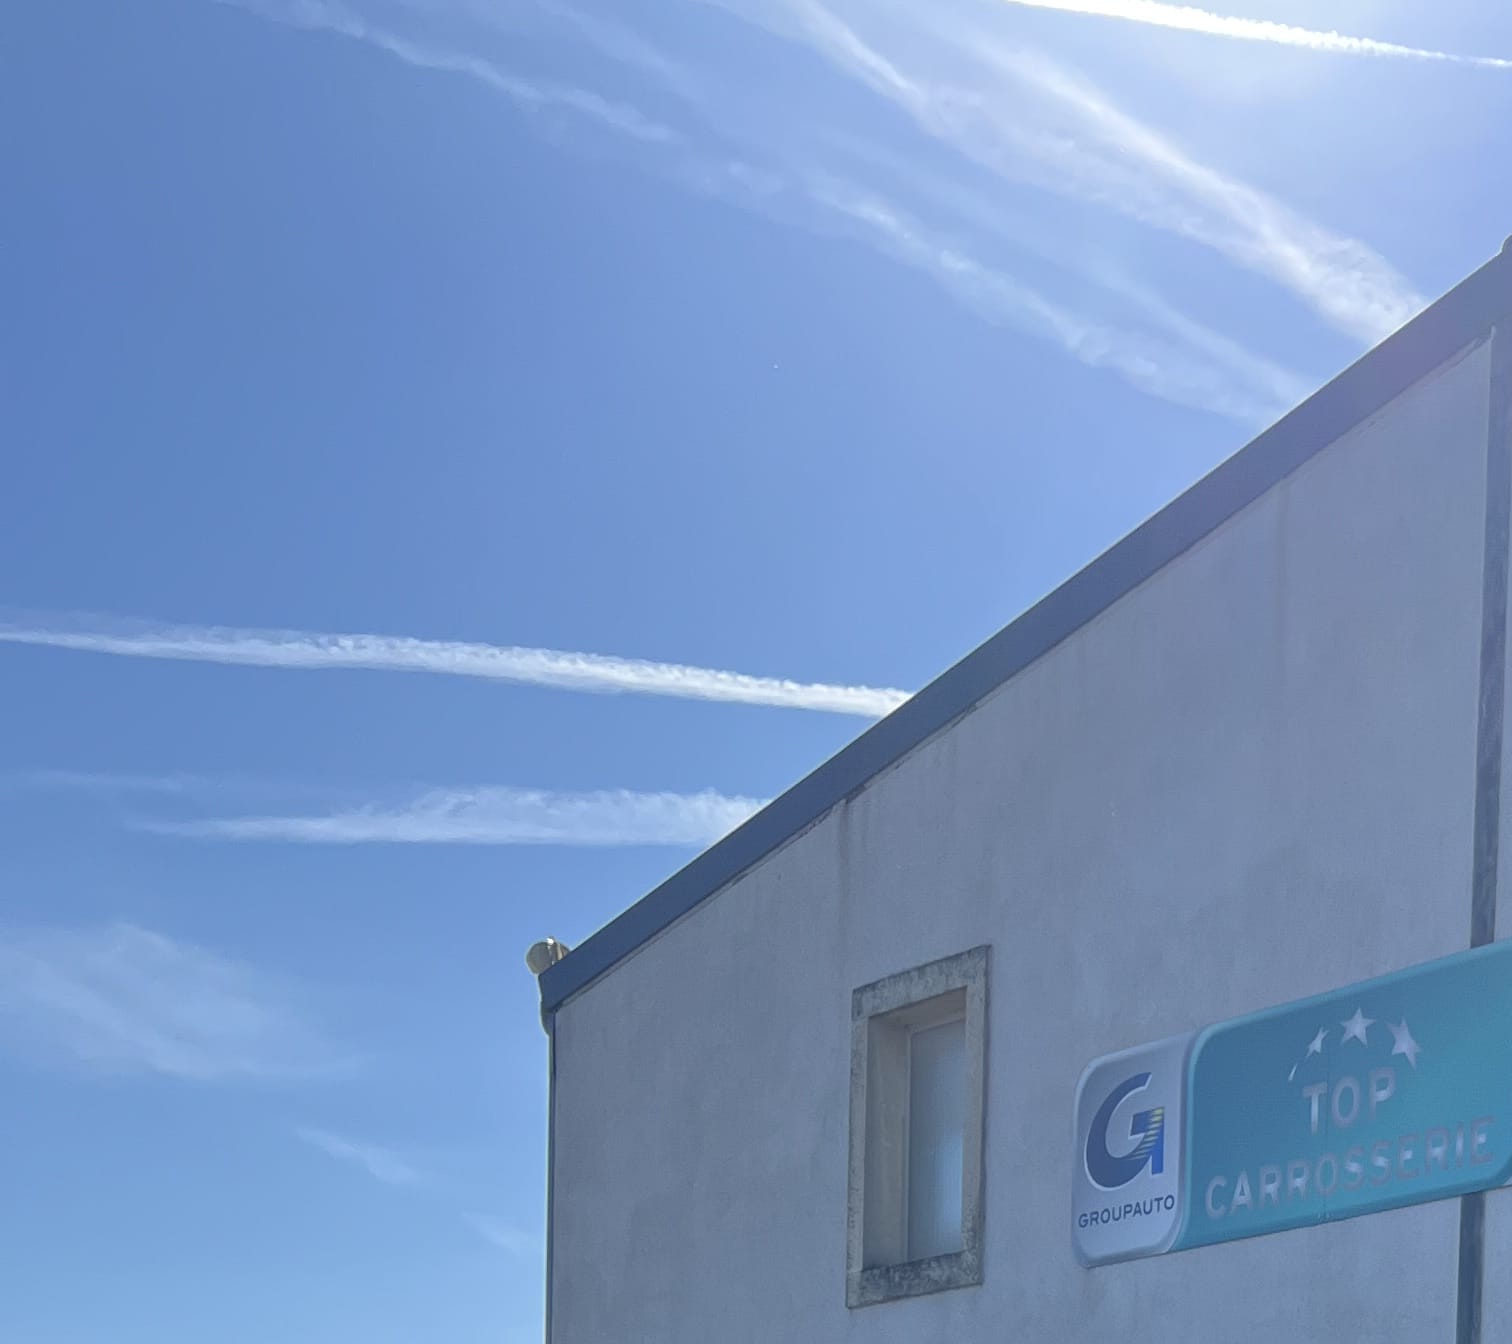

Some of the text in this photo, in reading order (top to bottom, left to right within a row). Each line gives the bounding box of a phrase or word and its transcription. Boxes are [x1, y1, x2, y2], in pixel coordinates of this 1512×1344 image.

[1303, 1066, 1398, 1135] TOP
[1205, 1115, 1495, 1220] CARROSSERIE
[1078, 1194, 1175, 1228] GROUPAUTO
